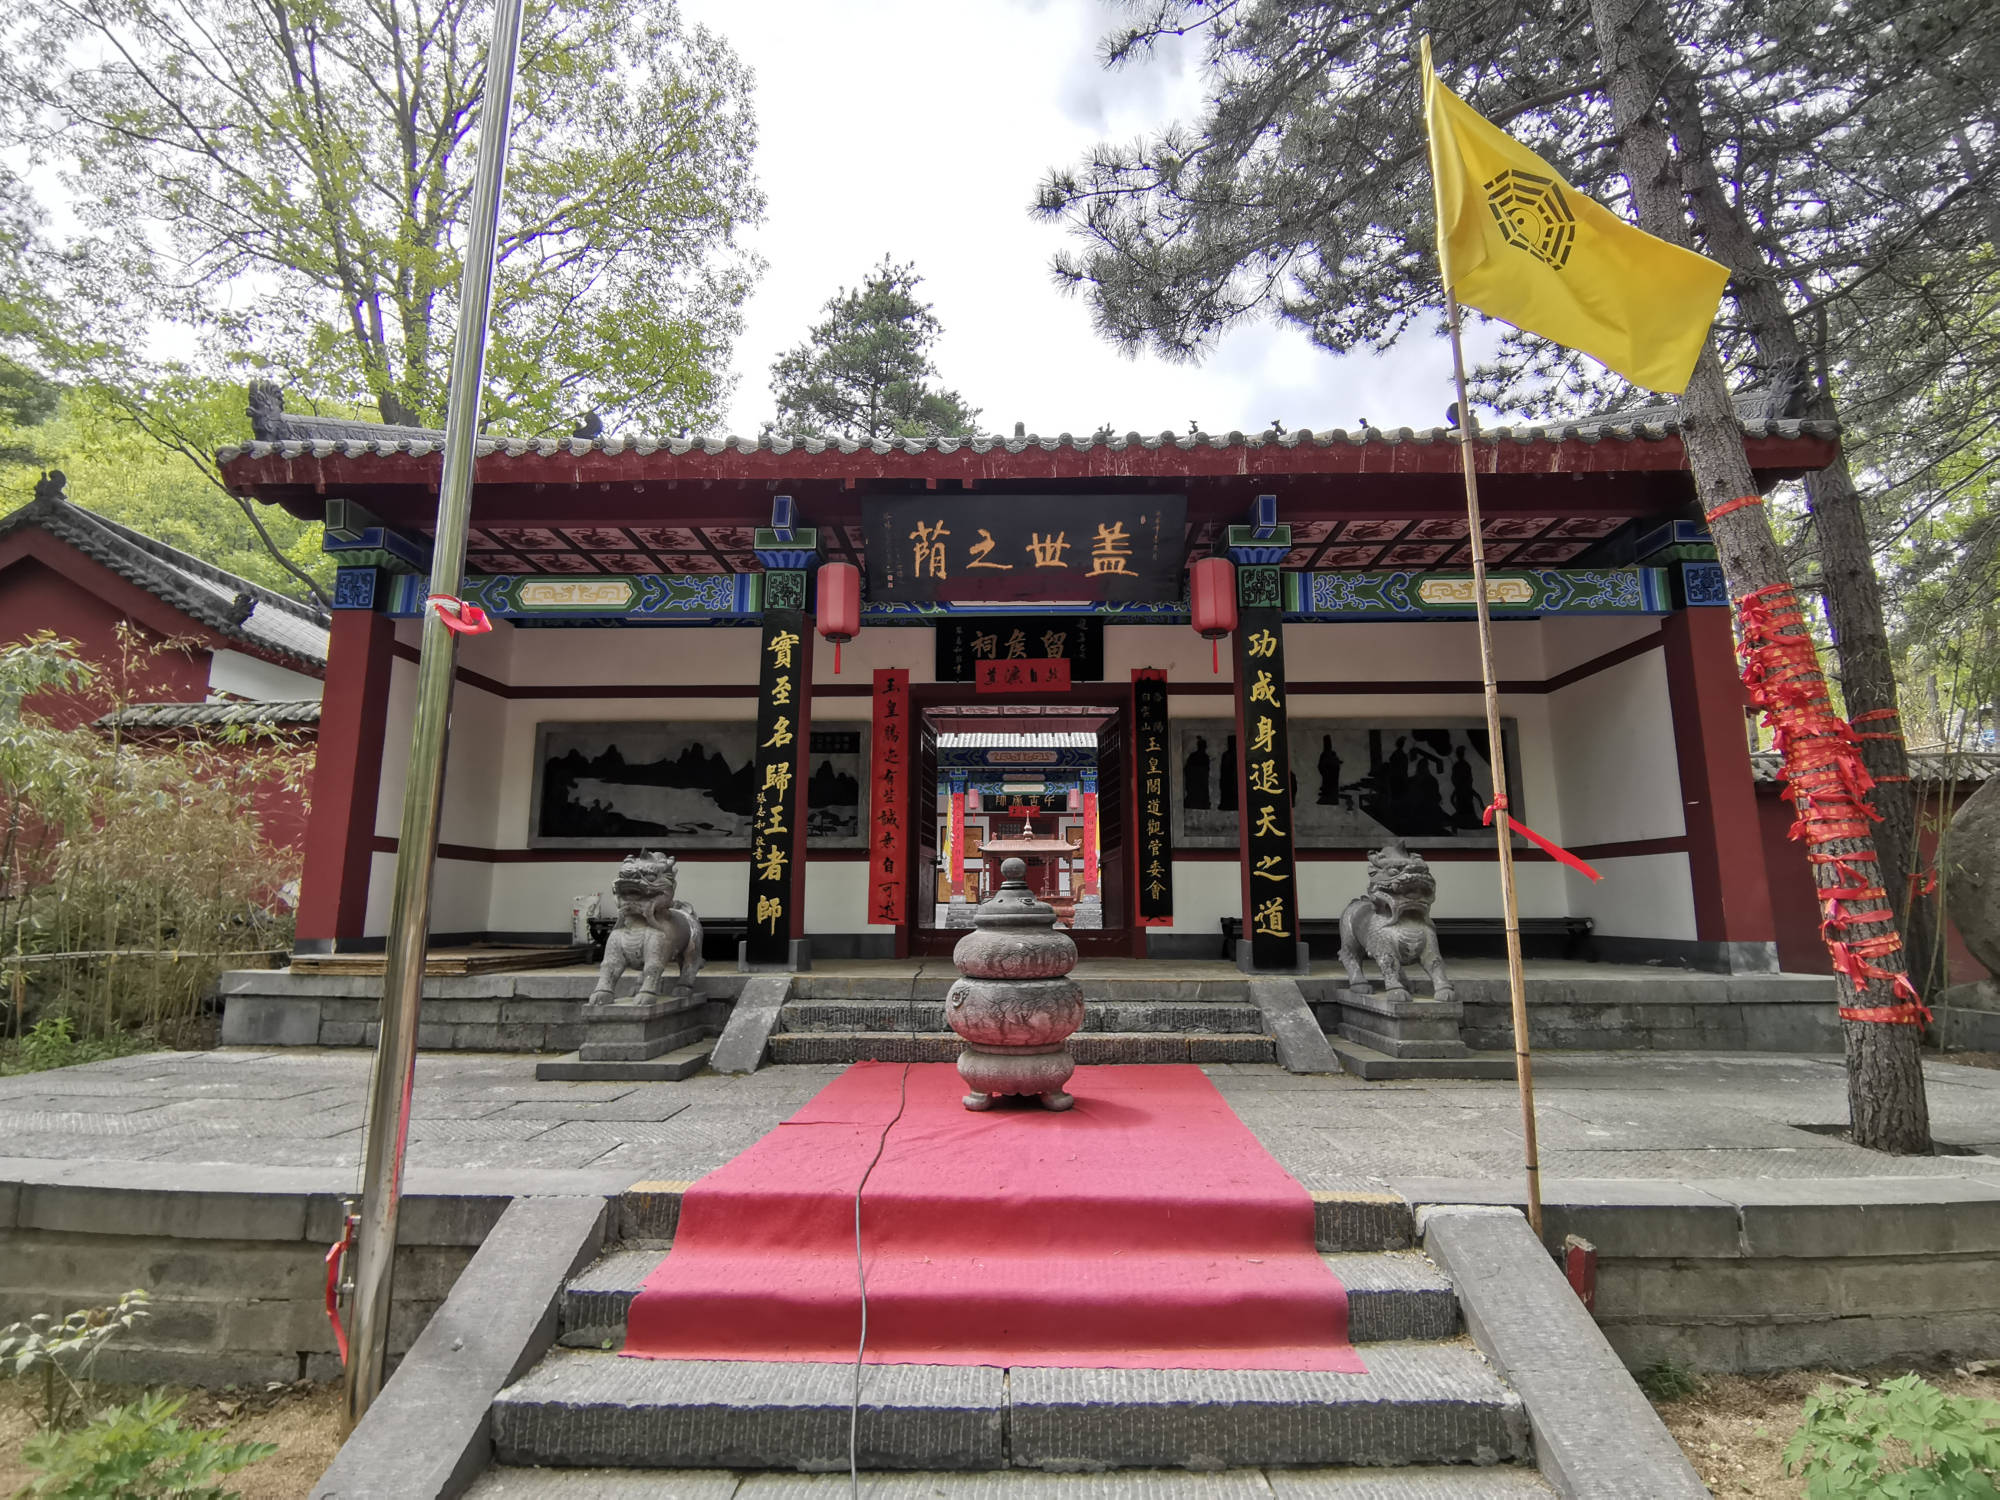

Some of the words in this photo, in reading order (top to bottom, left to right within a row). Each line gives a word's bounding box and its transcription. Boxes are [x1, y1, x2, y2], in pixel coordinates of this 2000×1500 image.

[1248, 629, 1291, 937] 功成身退天之道
